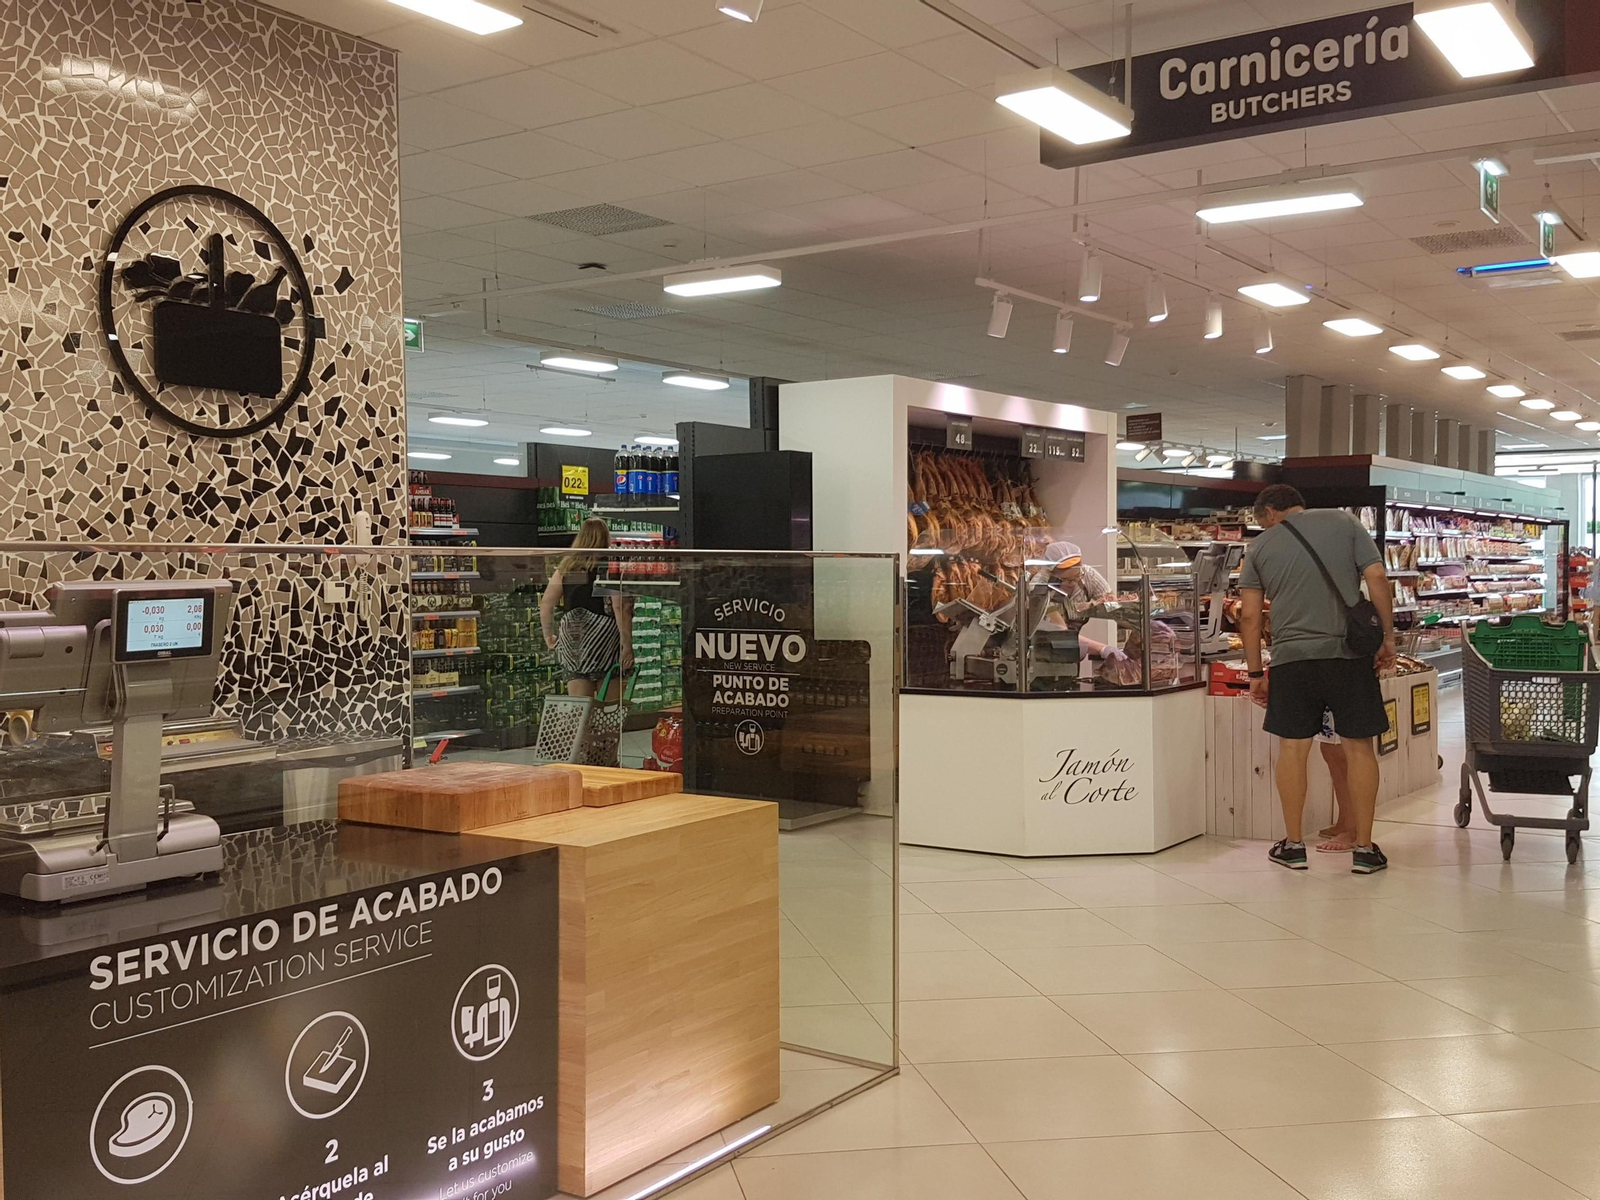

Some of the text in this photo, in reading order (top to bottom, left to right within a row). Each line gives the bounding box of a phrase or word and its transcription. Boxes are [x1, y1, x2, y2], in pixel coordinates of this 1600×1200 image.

[1159, 15, 1409, 100] Carnicería
[1211, 80, 1352, 124] BUTCHERS
[142, 604, 202, 616] -0,030 2,08
[714, 598, 786, 622] SERVICIO
[143, 622, 202, 634] 0,030 0,00
[695, 632, 807, 663] NUEVO
[723, 661, 776, 672] NEW SERVICE
[712, 674, 789, 692] PUNTO DE
[712, 690, 790, 708] ACABADO
[711, 706, 789, 719] PREPARATION POINT
[1038, 748, 1135, 783] Jamón
[1040, 776, 1139, 805] al Corte
[89, 866, 503, 991] SERVICIO DE ACABADO
[90, 920, 433, 1030] CUSTOMIZATION SERVICE
[481, 1078, 495, 1101] 3
[427, 1095, 544, 1155] Se la acabamos
[323, 1138, 339, 1164] 2
[448, 1128, 525, 1171] a su gusto
[373, 1154, 389, 1177] al
[439, 1150, 534, 1200] Let us customize
[473, 1180, 512, 1200] for you
